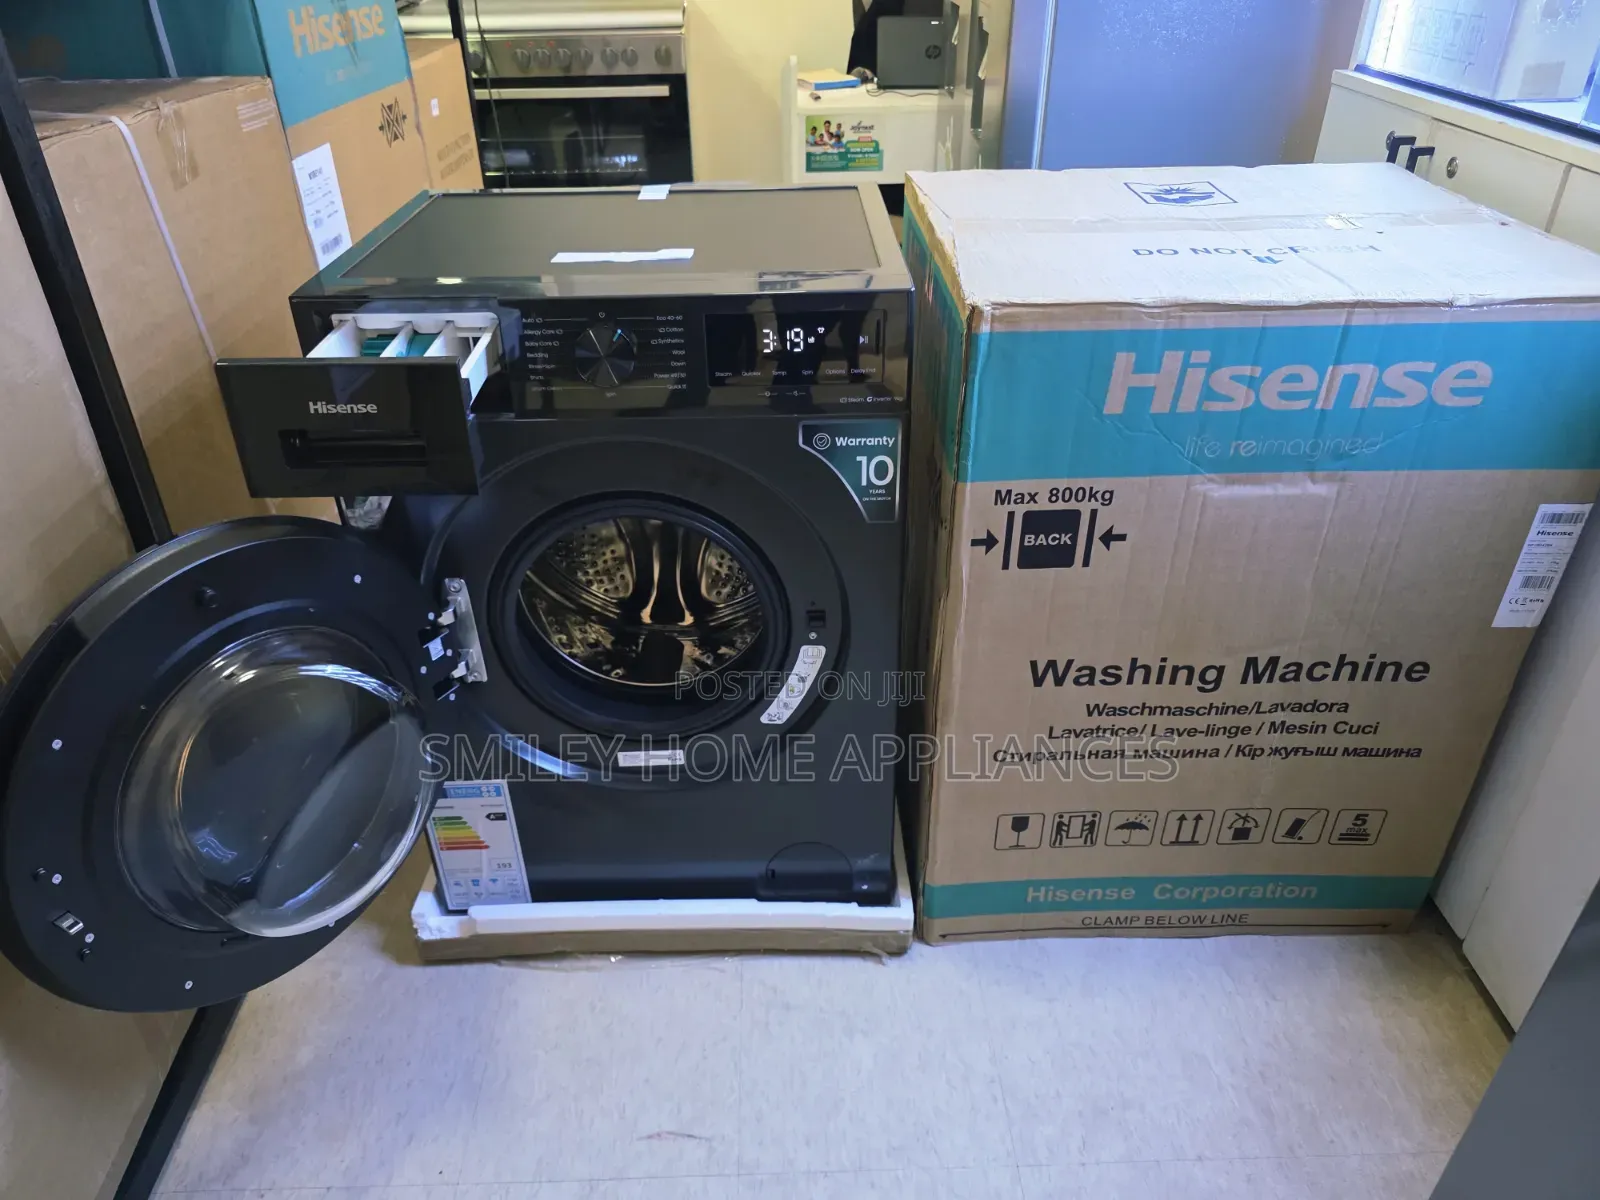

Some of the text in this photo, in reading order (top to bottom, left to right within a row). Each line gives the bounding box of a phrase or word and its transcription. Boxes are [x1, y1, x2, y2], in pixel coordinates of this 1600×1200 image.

[288, 4, 385, 58] Hisense
[1190, 247, 1253, 256] NOT
[763, 328, 804, 353] 3:19
[1103, 351, 1493, 415] Hisense
[308, 401, 378, 414] Hisense
[835, 436, 895, 447] Warranty
[1185, 432, 1383, 458] life reimagined
[856, 455, 894, 486] 10
[994, 487, 1115, 508] Max 800kg
[1023, 533, 1072, 548] BACK
[1029, 653, 1431, 693] Washing Machine
[1086, 699, 1349, 718] Waschmaschine/Lavadora
[1150, 722, 1252, 740] Lave-linge
[1267, 721, 1326, 735] Mesin
[1333, 720, 1380, 735] Cuci
[1133, 746, 1220, 762] машина
[1342, 744, 1422, 759] машина
[1351, 813, 1368, 827] 5
[1346, 826, 1367, 834] max
[1026, 883, 1318, 903] Hisense Corporation
[1081, 913, 1249, 927] CLAMP BELOW LINE
